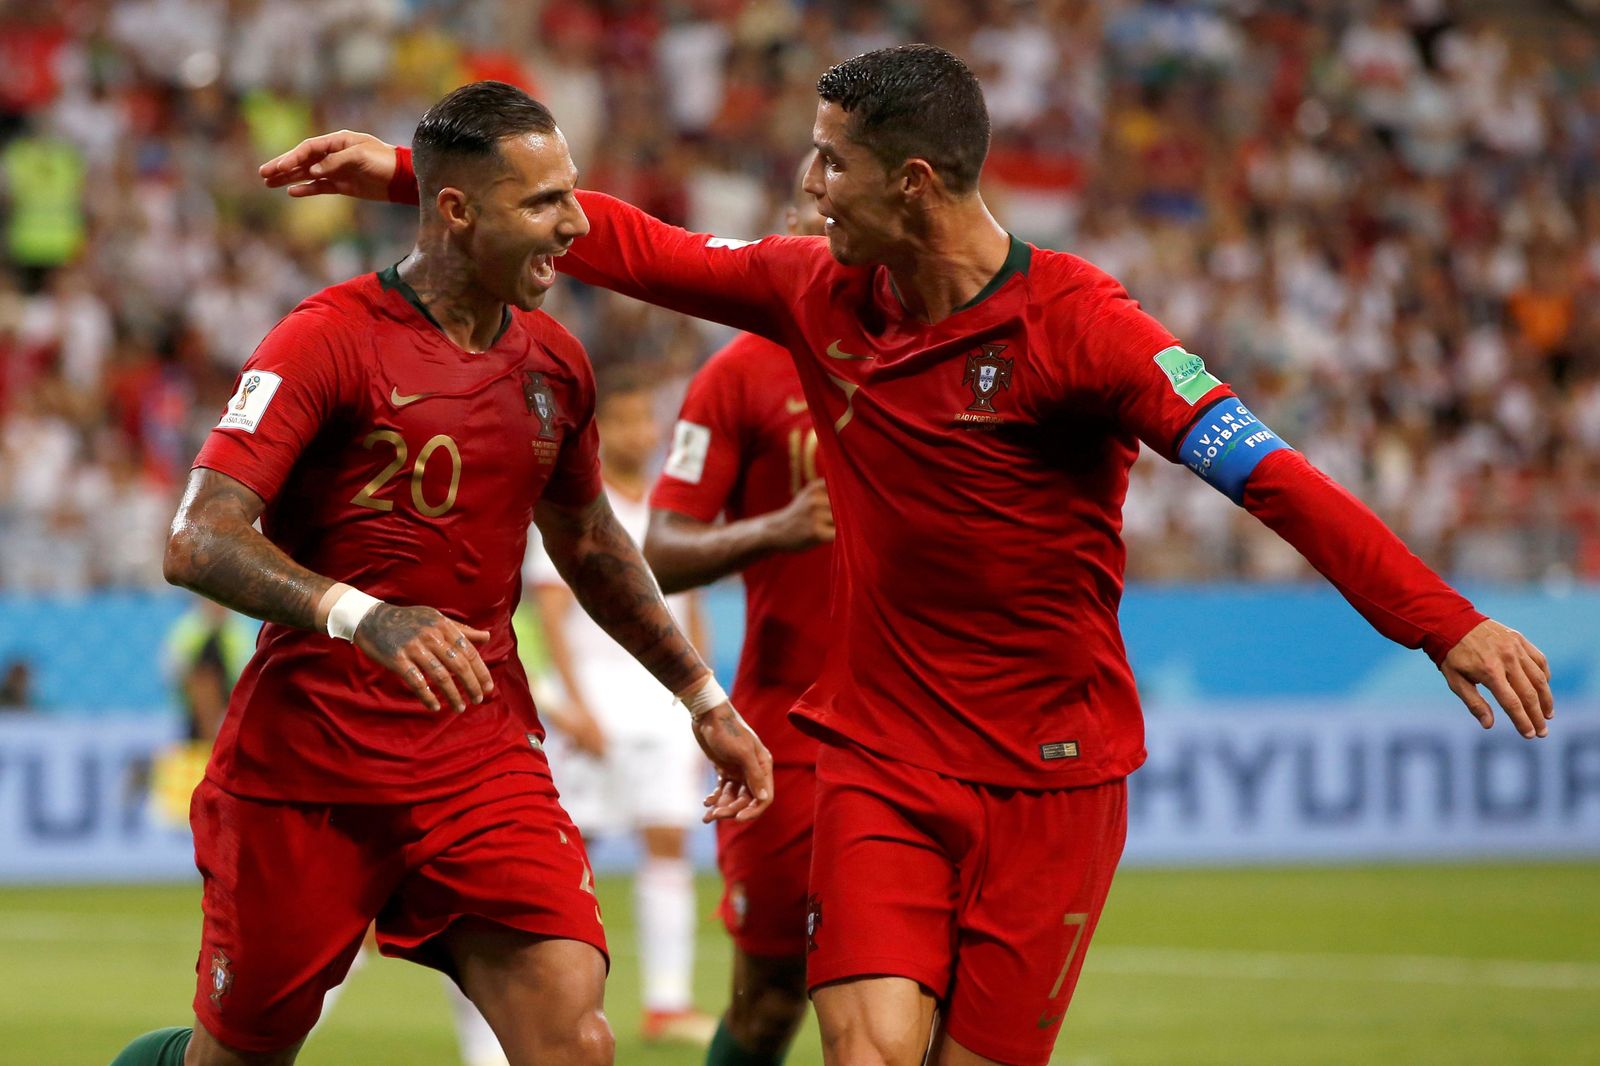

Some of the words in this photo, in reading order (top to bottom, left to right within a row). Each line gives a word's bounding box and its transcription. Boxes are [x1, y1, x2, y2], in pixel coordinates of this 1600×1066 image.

[1170, 357, 1202, 375] LIVING
[1189, 406, 1248, 470] LIVING
[1200, 415, 1257, 477] FOOTBALL
[1244, 430, 1275, 448] FIFA
[349, 429, 462, 518] 20
[1048, 912, 1089, 999] 7
